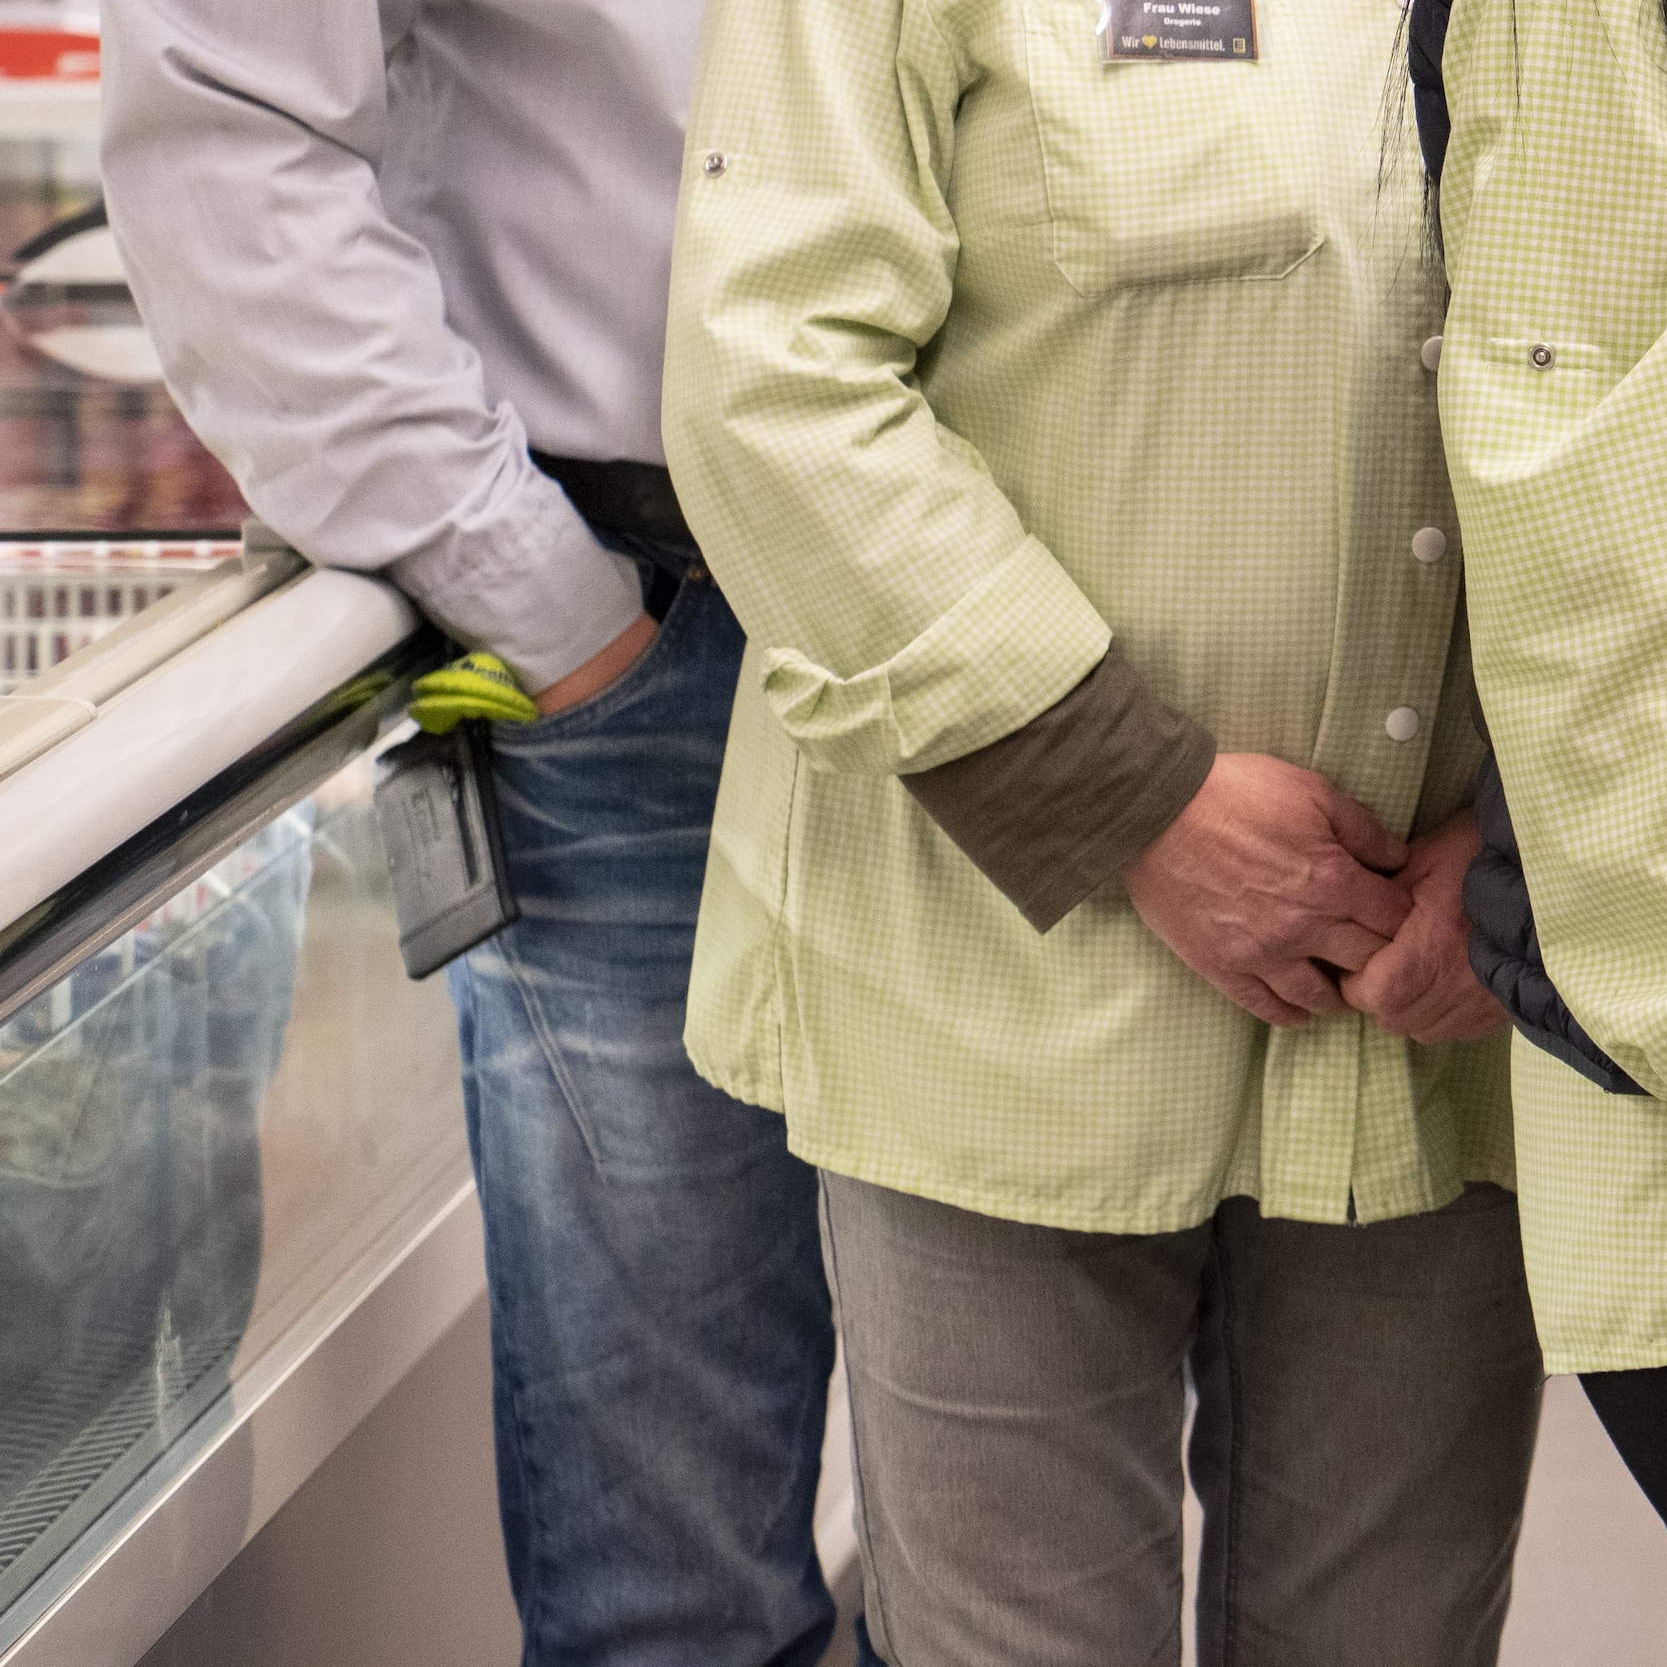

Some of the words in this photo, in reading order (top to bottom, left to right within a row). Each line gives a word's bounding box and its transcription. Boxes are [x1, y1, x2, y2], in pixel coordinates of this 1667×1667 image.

[1143, 2, 1175, 14] Frau
[1178, 3, 1221, 16] Wiese
[1163, 17, 1201, 27] Drogerie
[1122, 35, 1140, 48] Wir
[1159, 36, 1226, 52] Lebensmittel.
